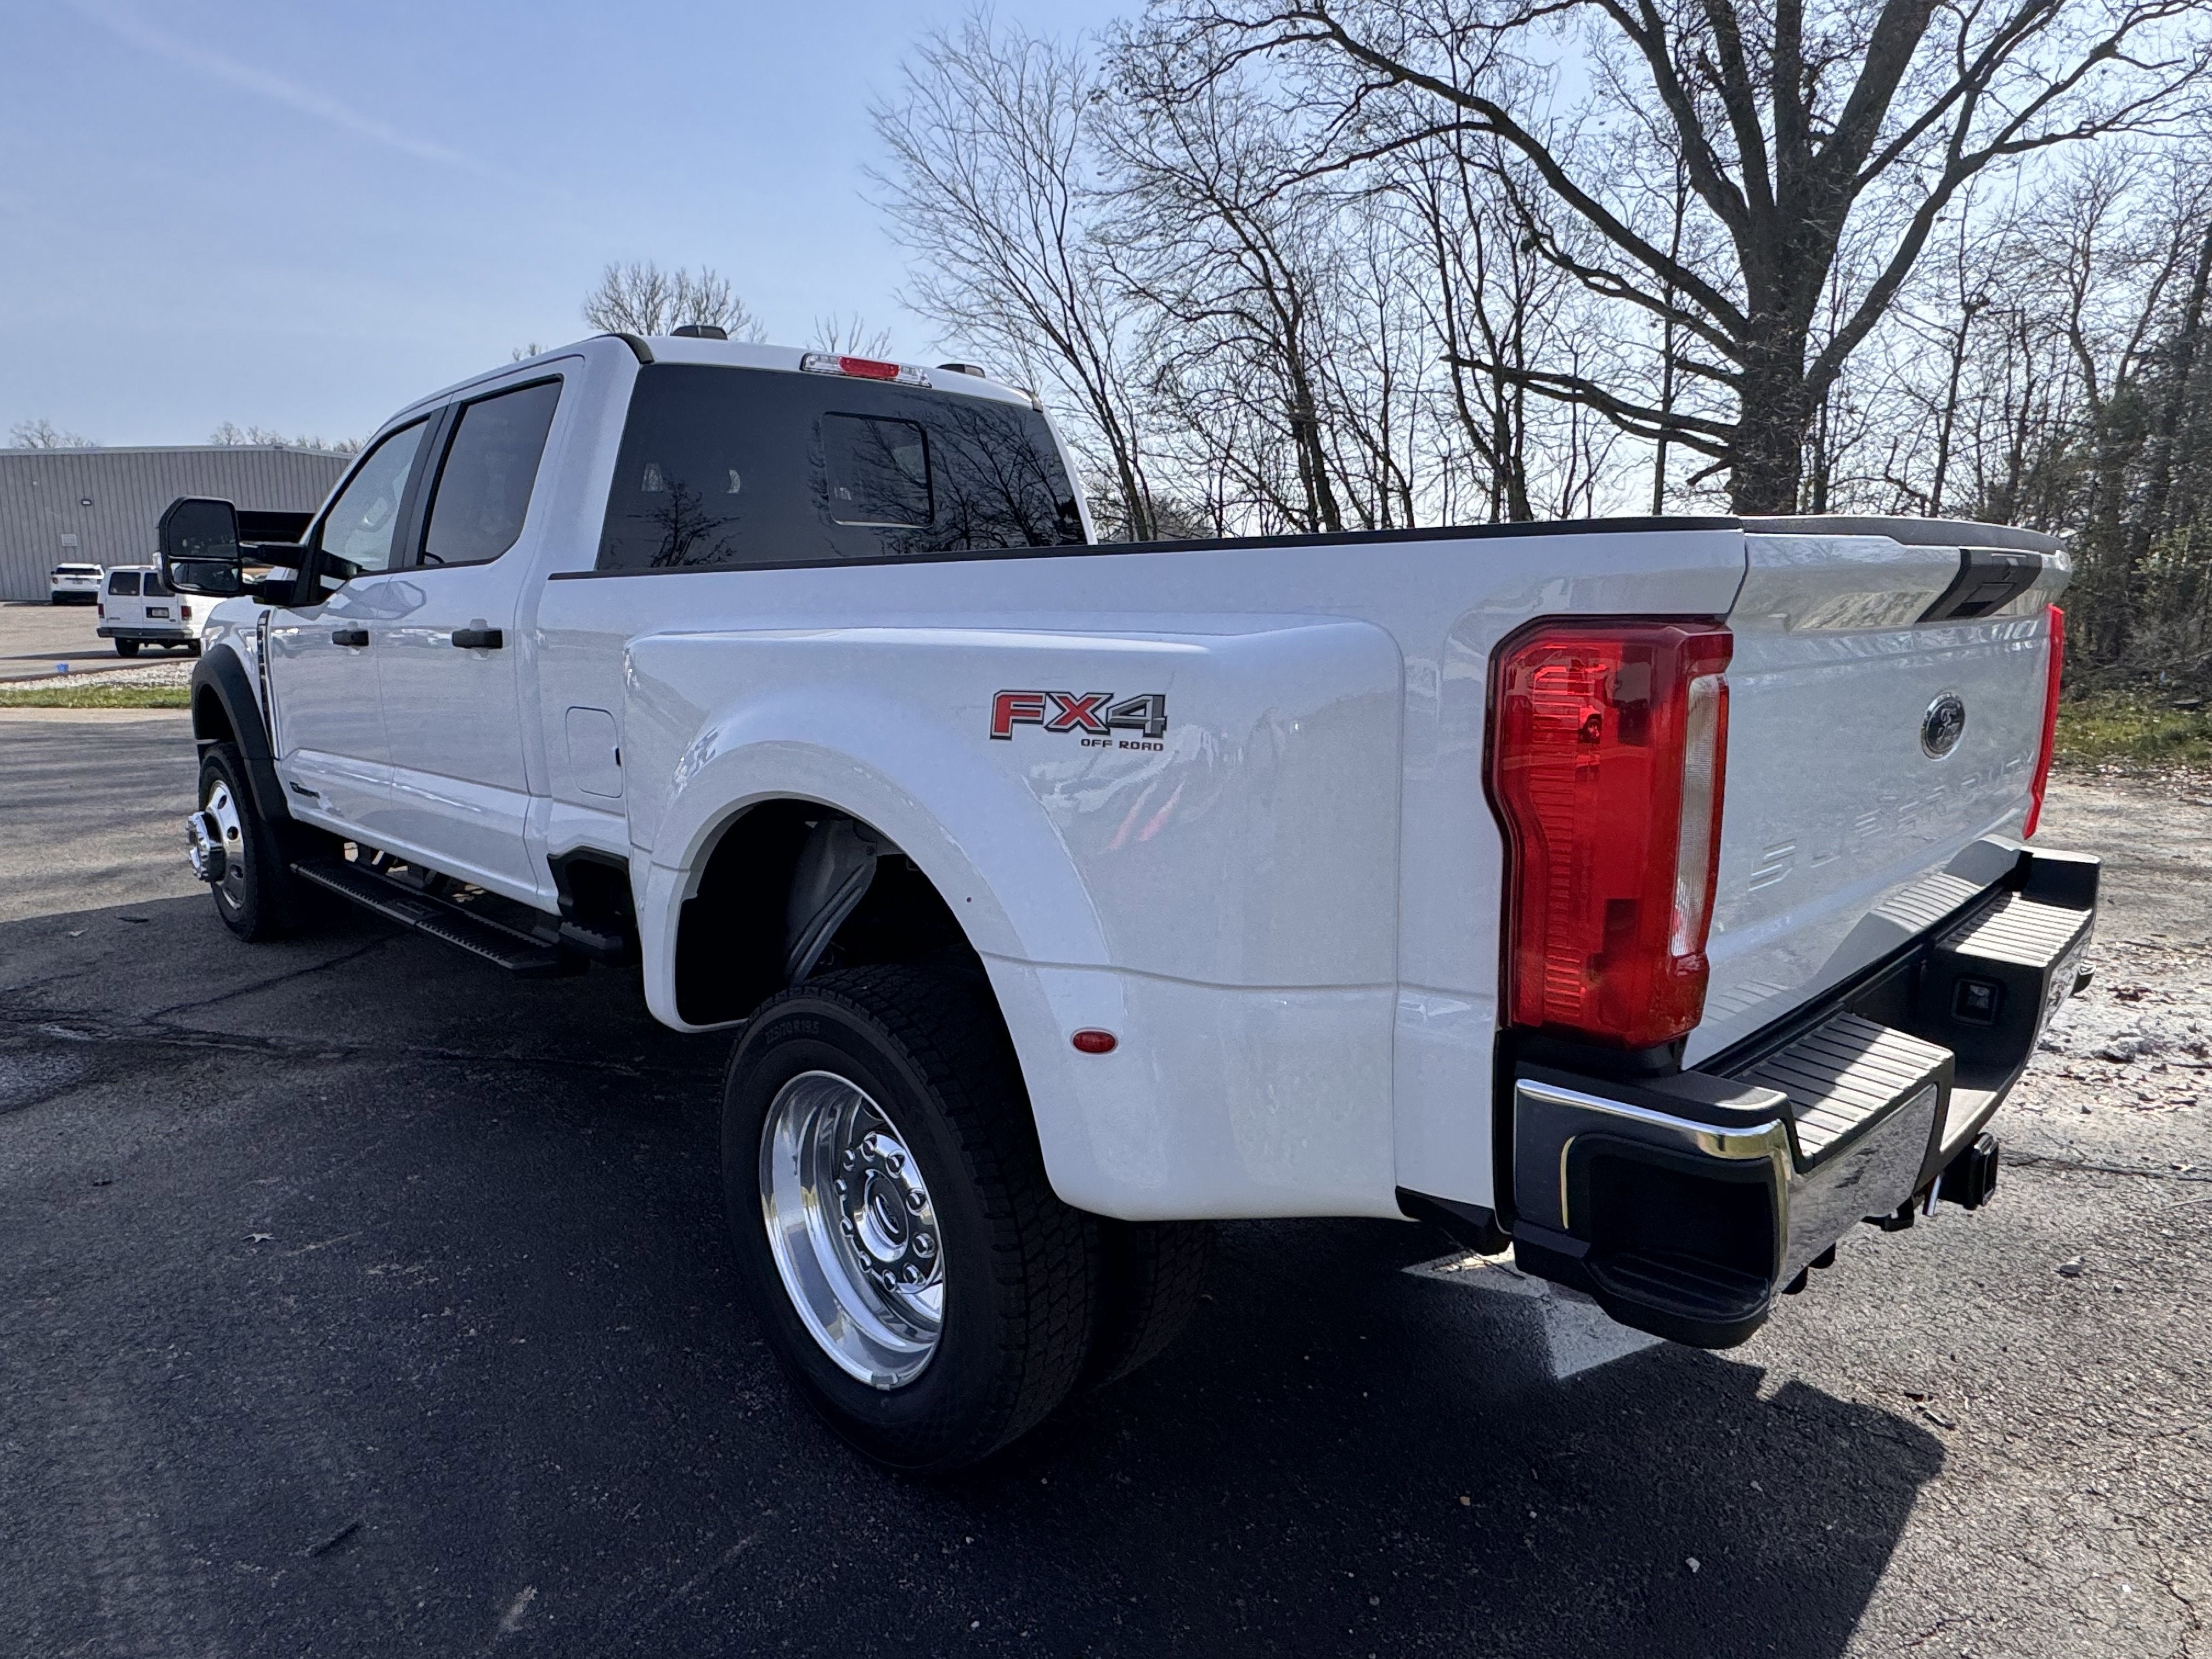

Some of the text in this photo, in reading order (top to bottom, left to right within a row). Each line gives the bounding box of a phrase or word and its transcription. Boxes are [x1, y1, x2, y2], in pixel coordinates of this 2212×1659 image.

[990, 690, 1167, 741] FX4
[1081, 738, 1164, 752] OFF ROAD
